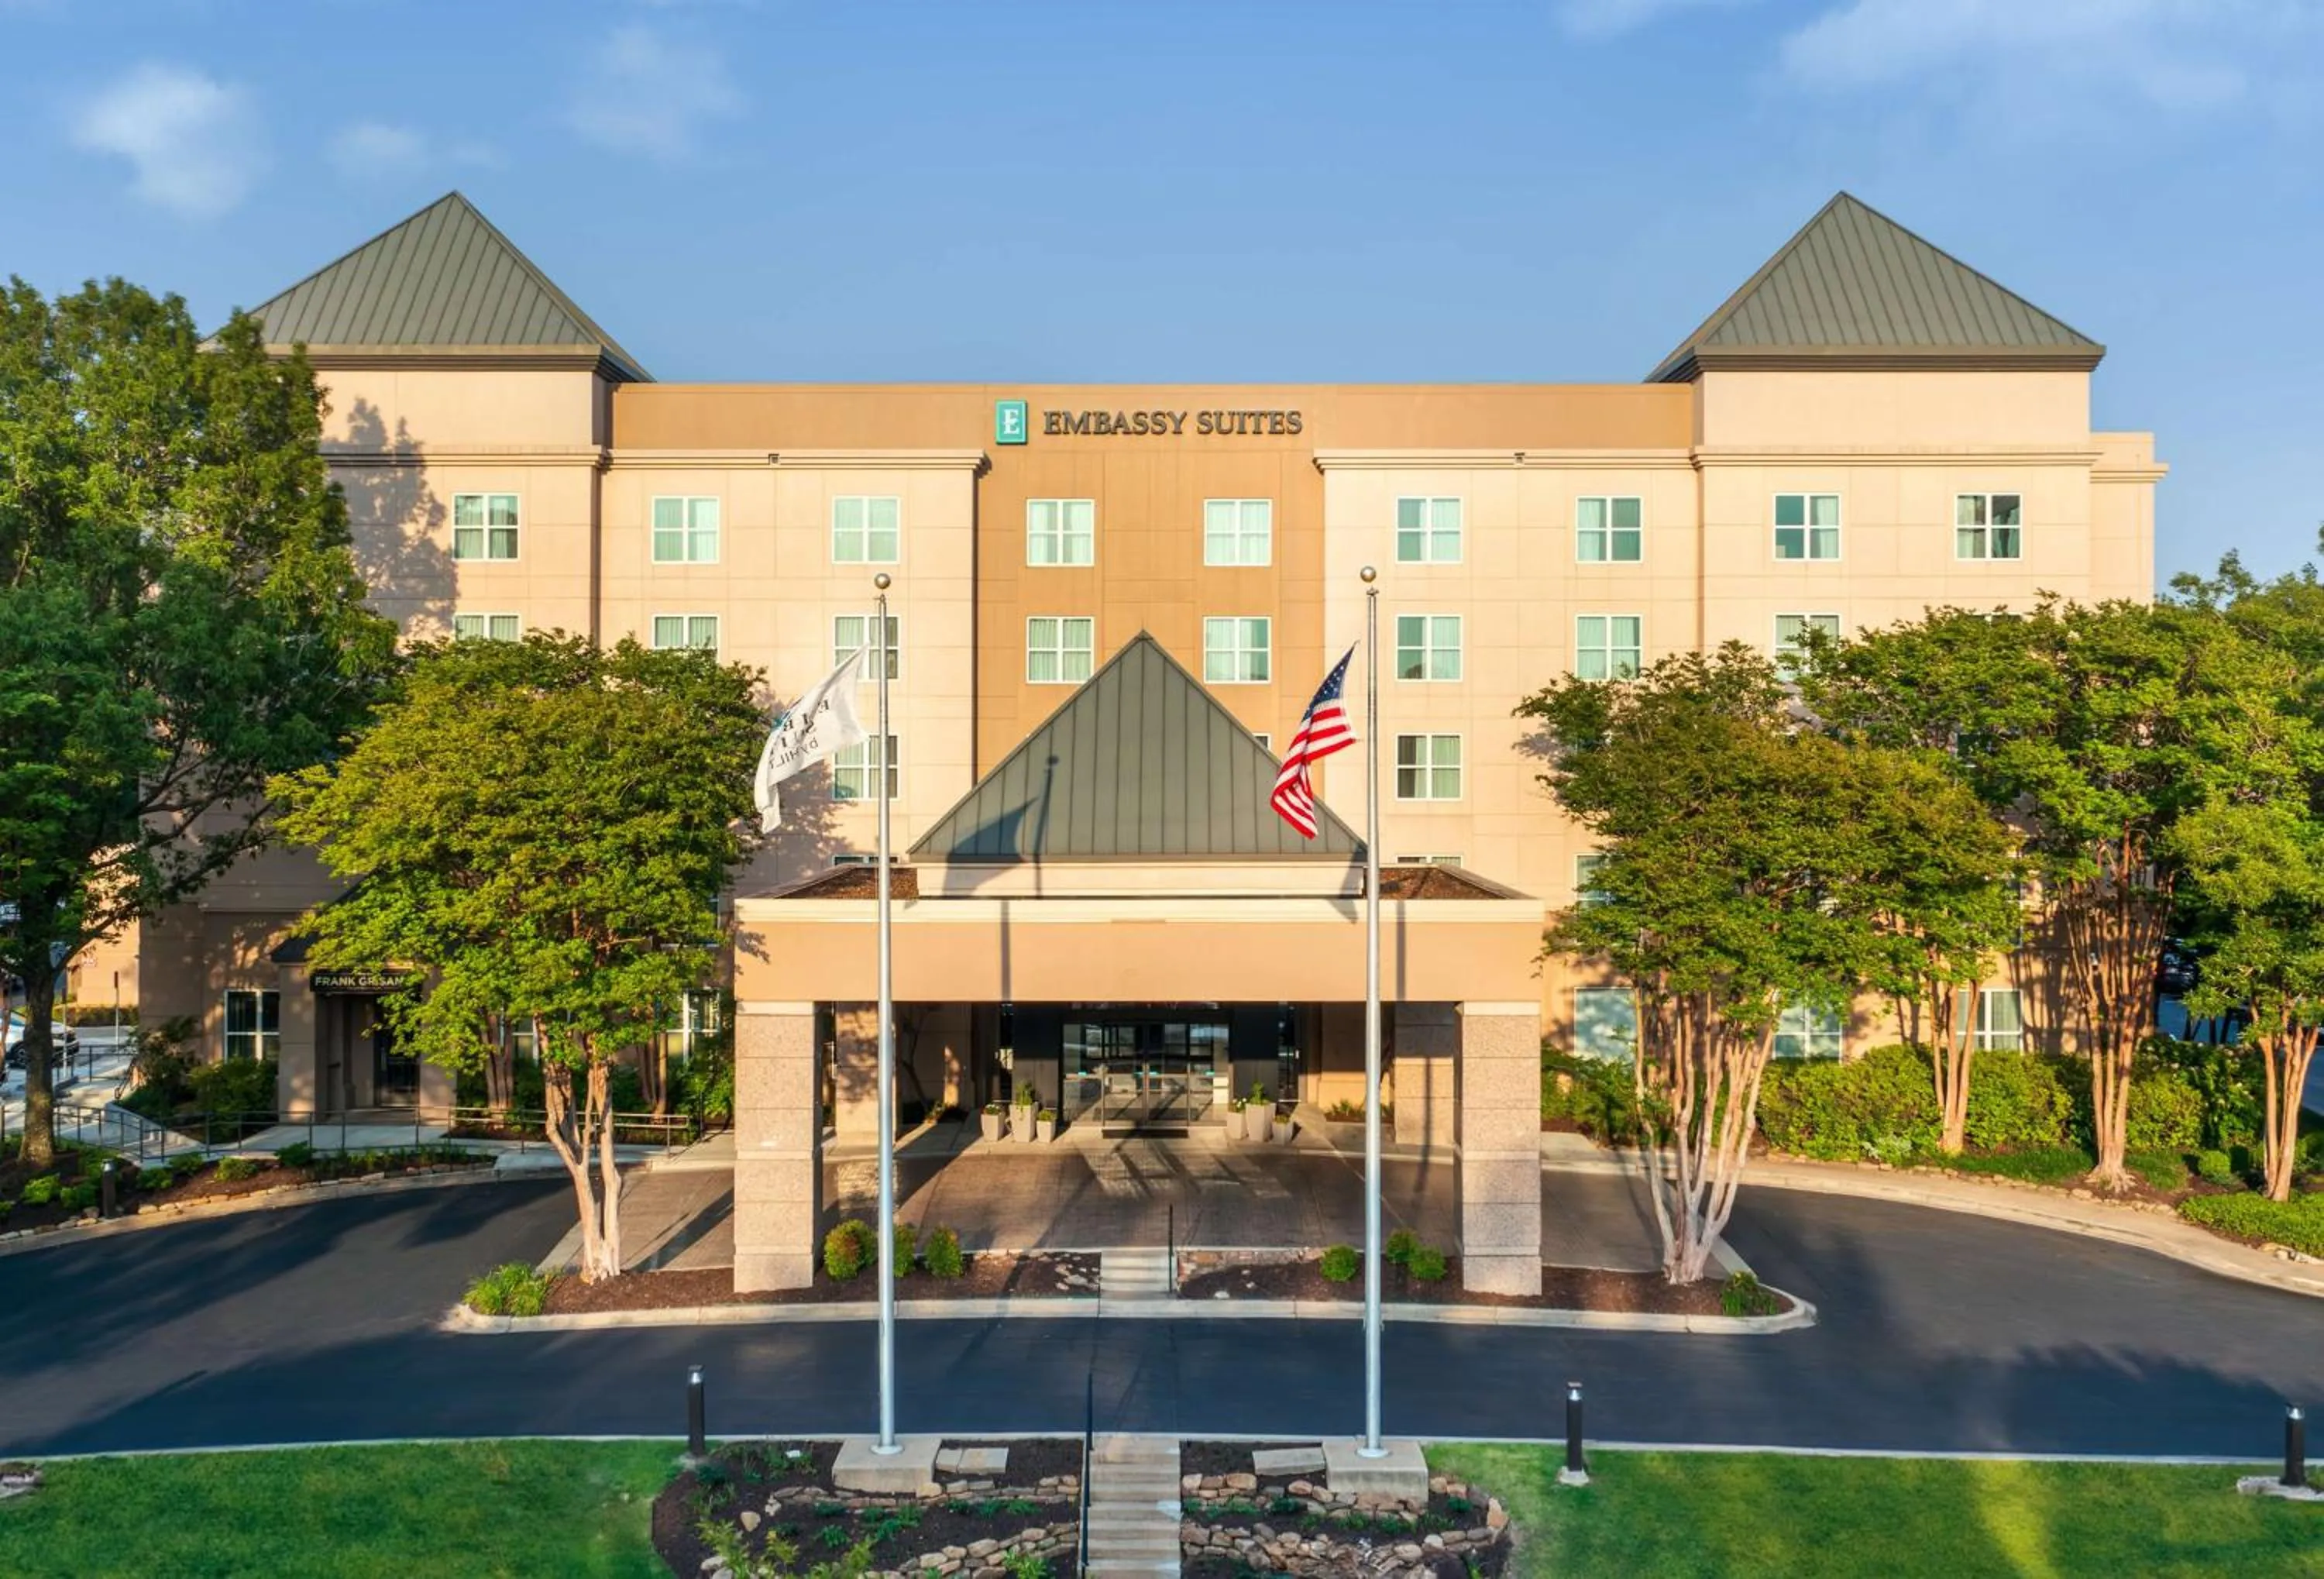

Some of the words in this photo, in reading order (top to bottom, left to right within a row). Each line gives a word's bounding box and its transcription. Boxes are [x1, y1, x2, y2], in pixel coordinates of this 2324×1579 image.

[1004, 408, 1019, 435] E
[1043, 410, 1188, 435] EMBASSY
[1196, 410, 1303, 435] SUITES
[315, 976, 356, 986] FRANK
[359, 976, 403, 986] GRSAN
